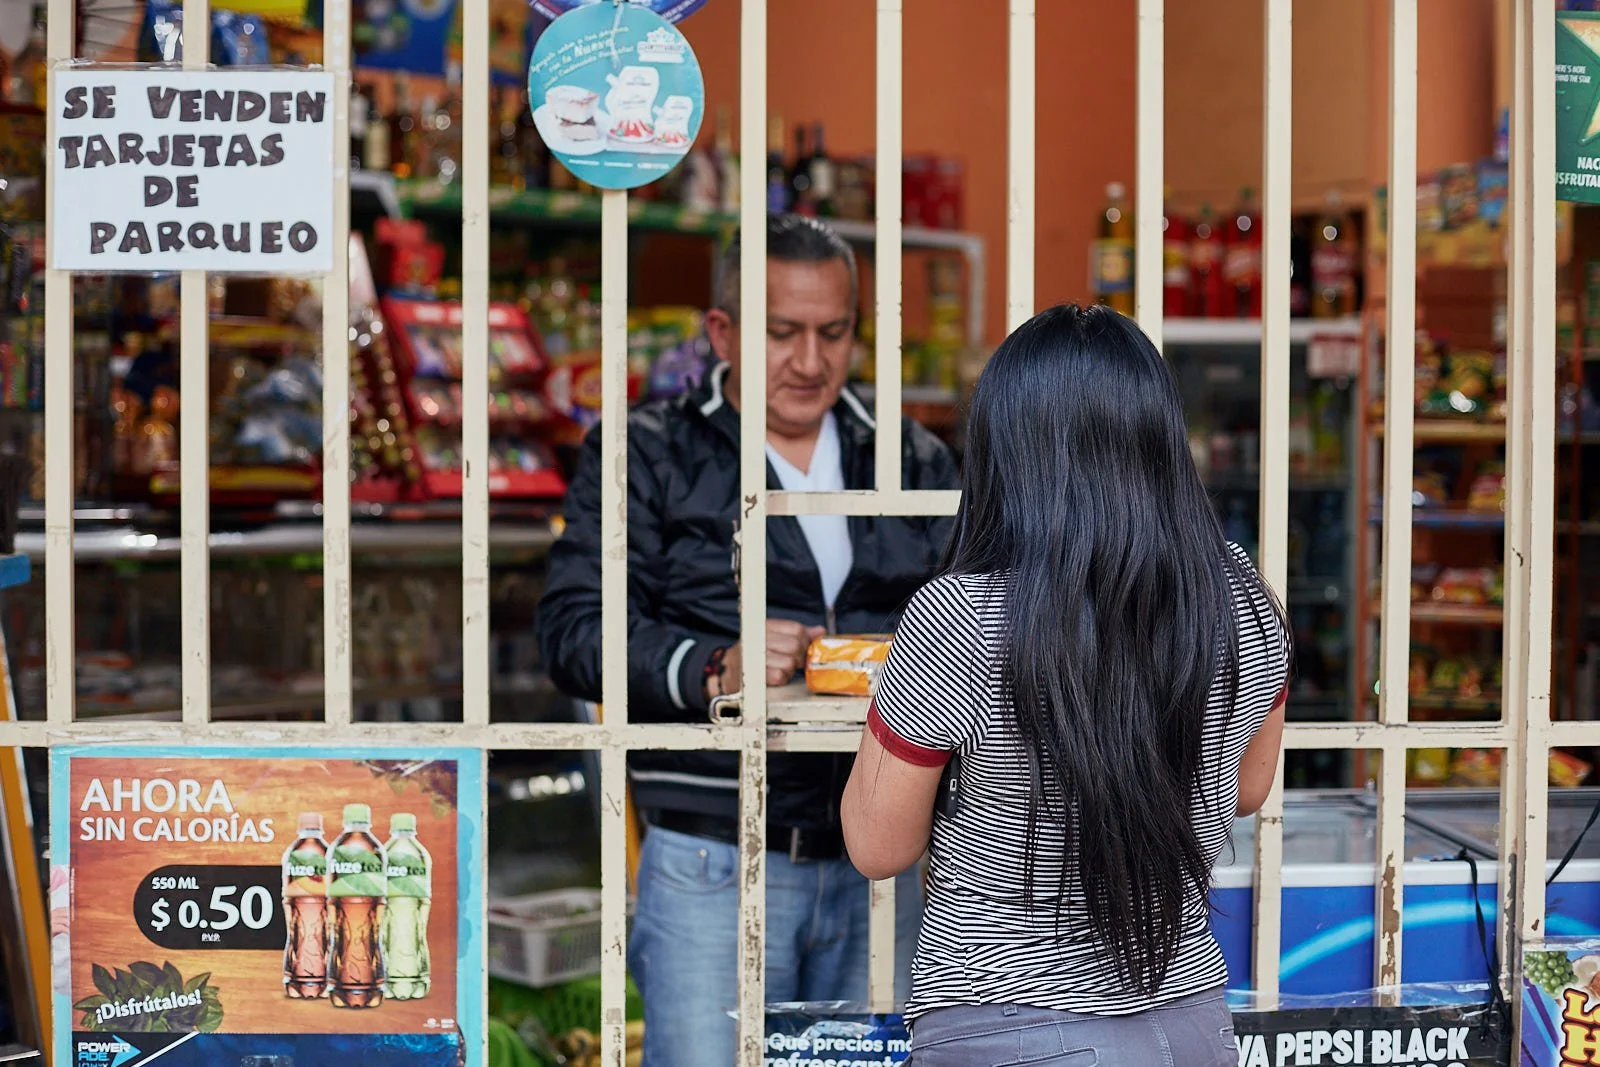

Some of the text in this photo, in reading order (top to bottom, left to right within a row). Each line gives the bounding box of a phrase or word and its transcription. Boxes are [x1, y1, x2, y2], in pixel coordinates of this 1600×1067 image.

[62, 85, 326, 124] SE VENDEN
[58, 132, 285, 169] TARJETAS
[1577, 156, 1600, 171] NAC
[143, 174, 200, 208] DE
[1555, 171, 1600, 189] ISFRUTA
[89, 221, 318, 255] PARQUEO
[79, 777, 235, 813] AHORA
[79, 811, 276, 842] SIN CALORÍAS
[151, 876, 200, 890] 550 ML
[150, 885, 274, 931] $ 0.50
[95, 989, 202, 1024] ¡Disfrútalos!
[77, 1042, 130, 1053] POWER
[812, 1034, 884, 1056] precios
[1276, 1029, 1364, 1067] PEPSI
[1371, 1027, 1470, 1064] BLACK
